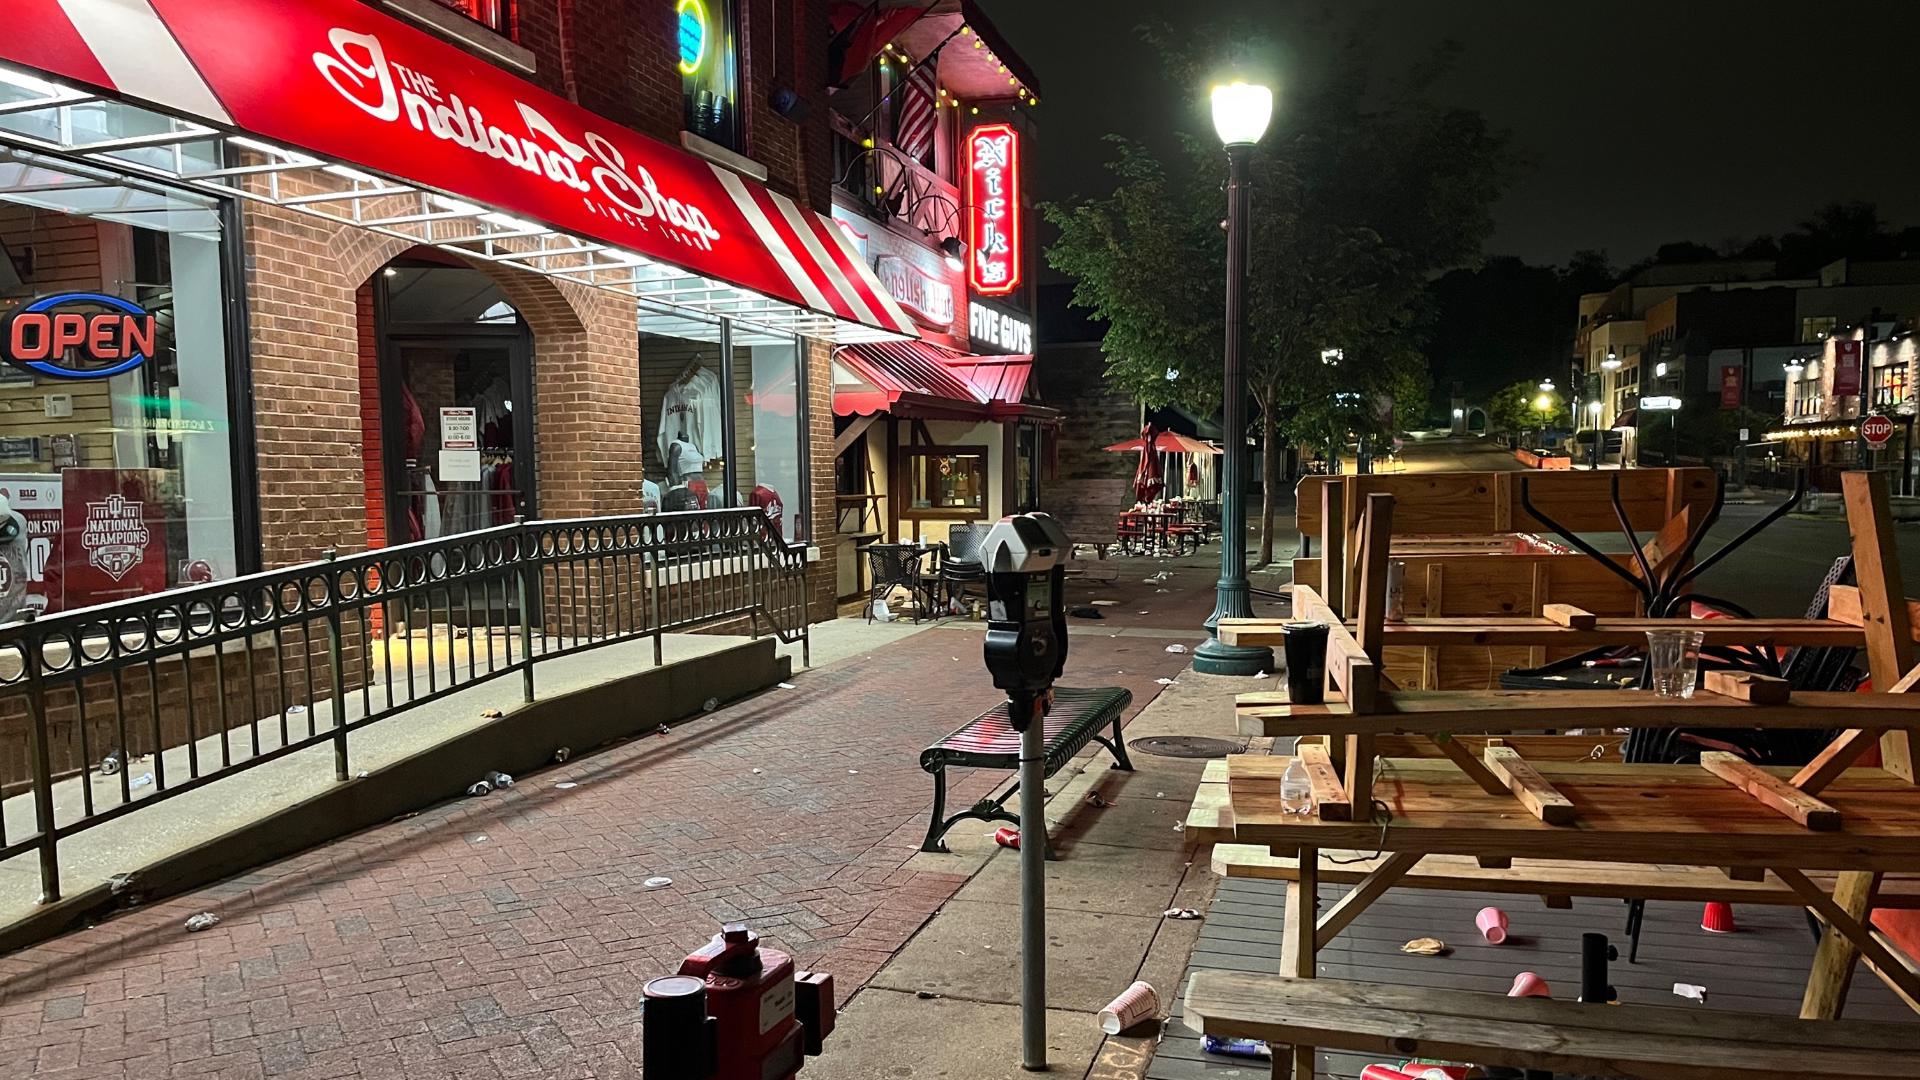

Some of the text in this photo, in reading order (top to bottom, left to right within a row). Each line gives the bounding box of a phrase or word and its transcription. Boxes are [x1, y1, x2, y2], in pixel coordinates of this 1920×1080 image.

[391, 61, 444, 100] THE
[313, 28, 720, 251] Indiana Shop
[583, 197, 649, 232] SINCE
[11, 313, 155, 360] OPEN
[970, 301, 1032, 356] FIVE GUYS
[1864, 423, 1891, 435] STOP
[84, 530, 148, 546] CHAMPIONS
[89, 518, 142, 533] NATIONAL
